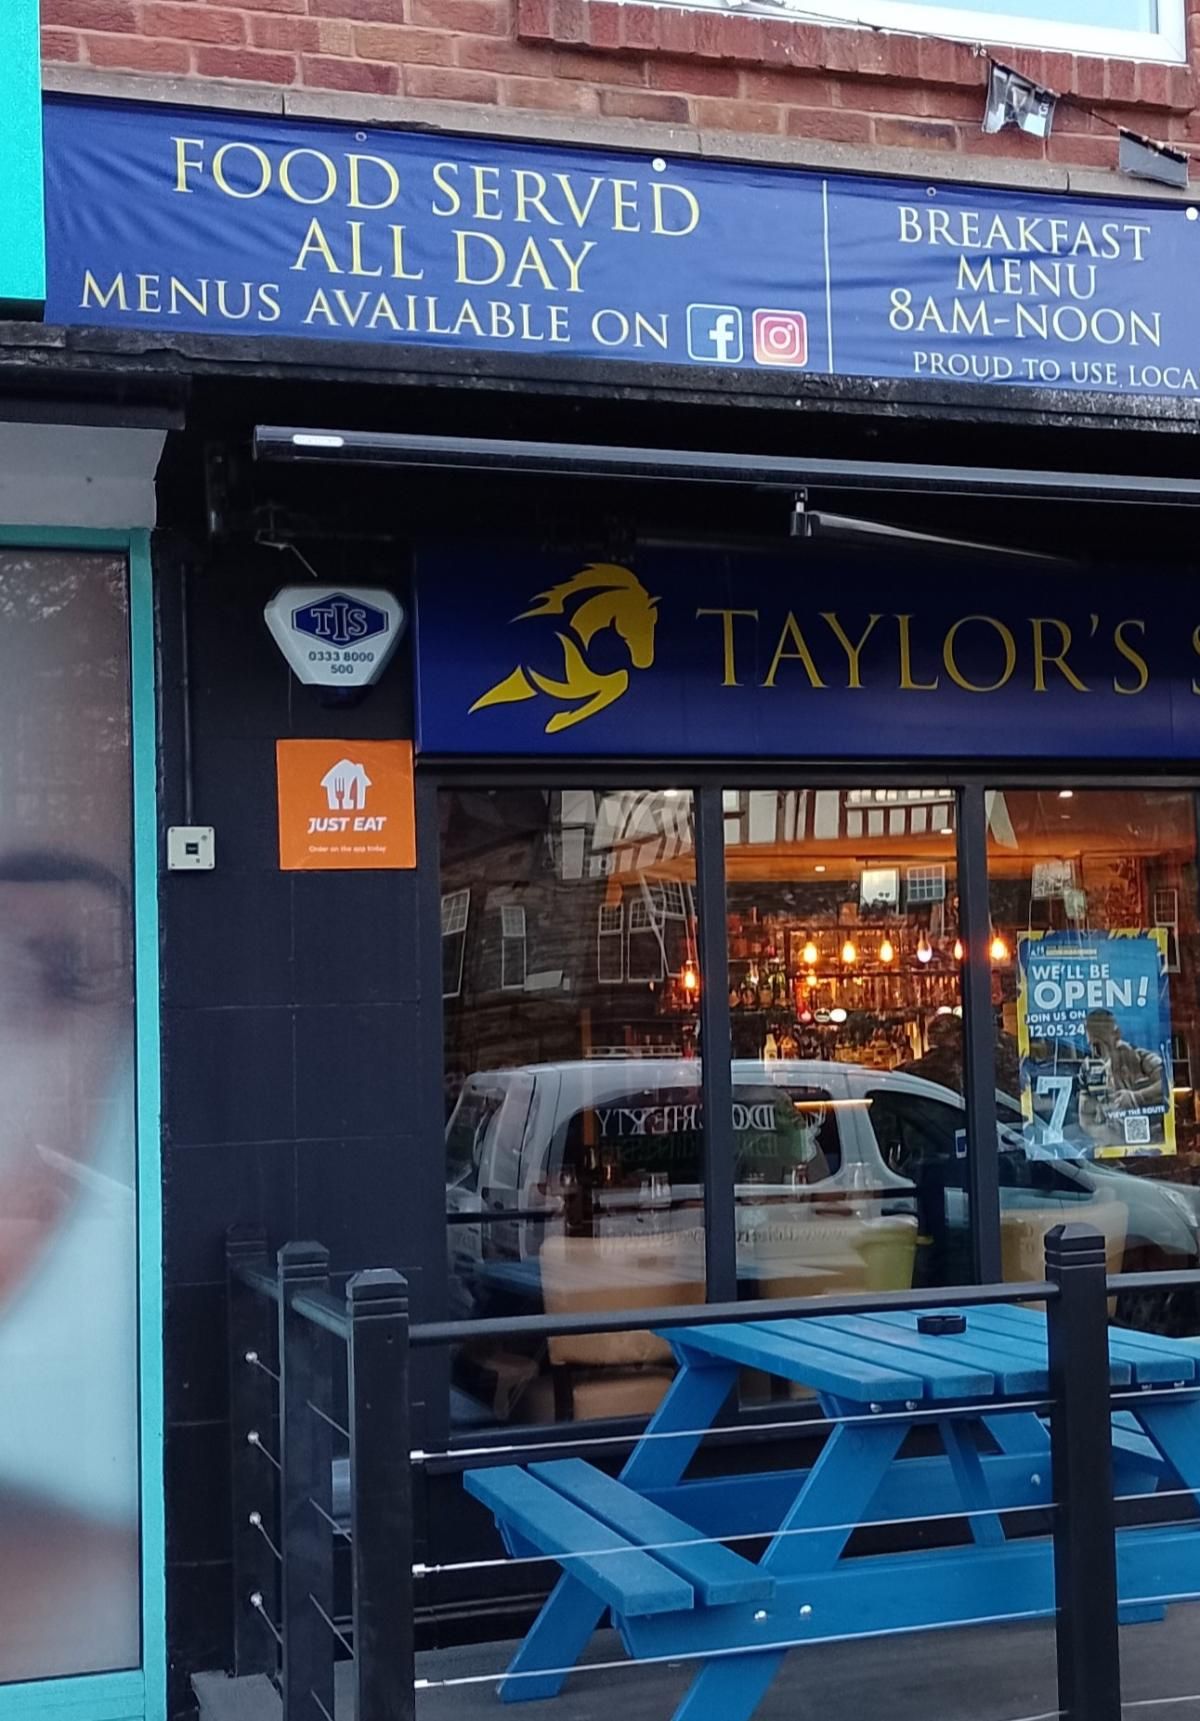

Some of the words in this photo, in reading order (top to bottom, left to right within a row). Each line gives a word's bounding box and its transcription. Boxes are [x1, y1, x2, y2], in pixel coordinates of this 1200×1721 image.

[171, 136, 400, 209] FOOD
[432, 162, 701, 237] SERVED
[898, 206, 1150, 261] BREAKFAST
[290, 218, 424, 279] ALL
[453, 229, 597, 293] DAY
[956, 254, 1098, 300] MENU
[80, 270, 282, 321] MENUS
[303, 288, 571, 343] AVAILABLE
[591, 309, 668, 349] ON
[888, 288, 1162, 347] 8AM-NOON
[913, 352, 1012, 378] PROUD
[1022, 358, 1061, 382] TO
[310, 602, 368, 642] TIS
[308, 651, 341, 662] 0333
[343, 651, 375, 663] 8000
[330, 664, 354, 674] 500
[696, 608, 1149, 695] TAYLOR'S
[307, 817, 350, 834] JUST
[353, 816, 387, 832] EAT
[1032, 964, 1084, 980] WE'LL
[1090, 964, 1109, 979] BE
[1034, 976, 1149, 1010] OPEN!
[1026, 1012, 1051, 1024] JOIN
[1053, 1011, 1067, 1021] US
[1069, 1010, 1087, 1020] ON
[1029, 1022, 1086, 1037] 12.05.24
[1036, 1076, 1073, 1146] 7
